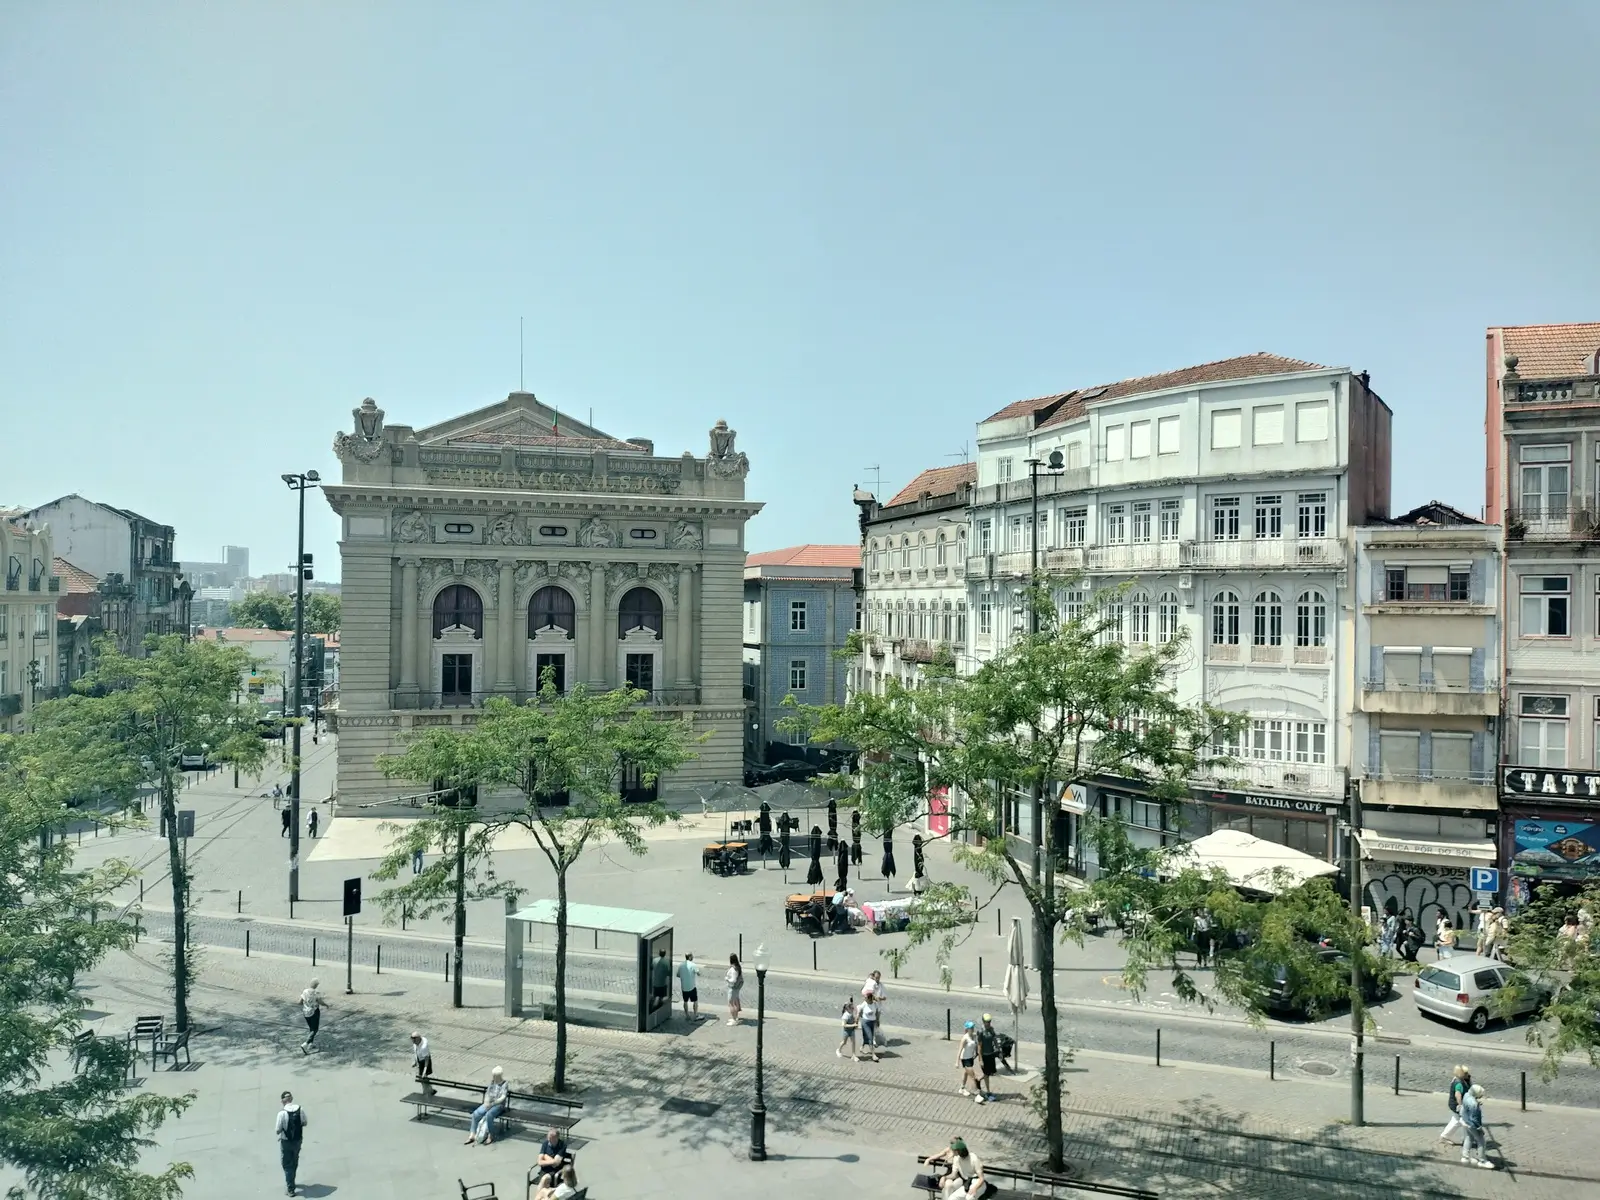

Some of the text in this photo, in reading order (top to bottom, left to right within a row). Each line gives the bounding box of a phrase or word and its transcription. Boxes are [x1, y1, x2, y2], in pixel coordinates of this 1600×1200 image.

[428, 467, 507, 485] EATRO
[1245, 796, 1322, 812] BATALHA CAFÉ
[1476, 869, 1493, 889] P
